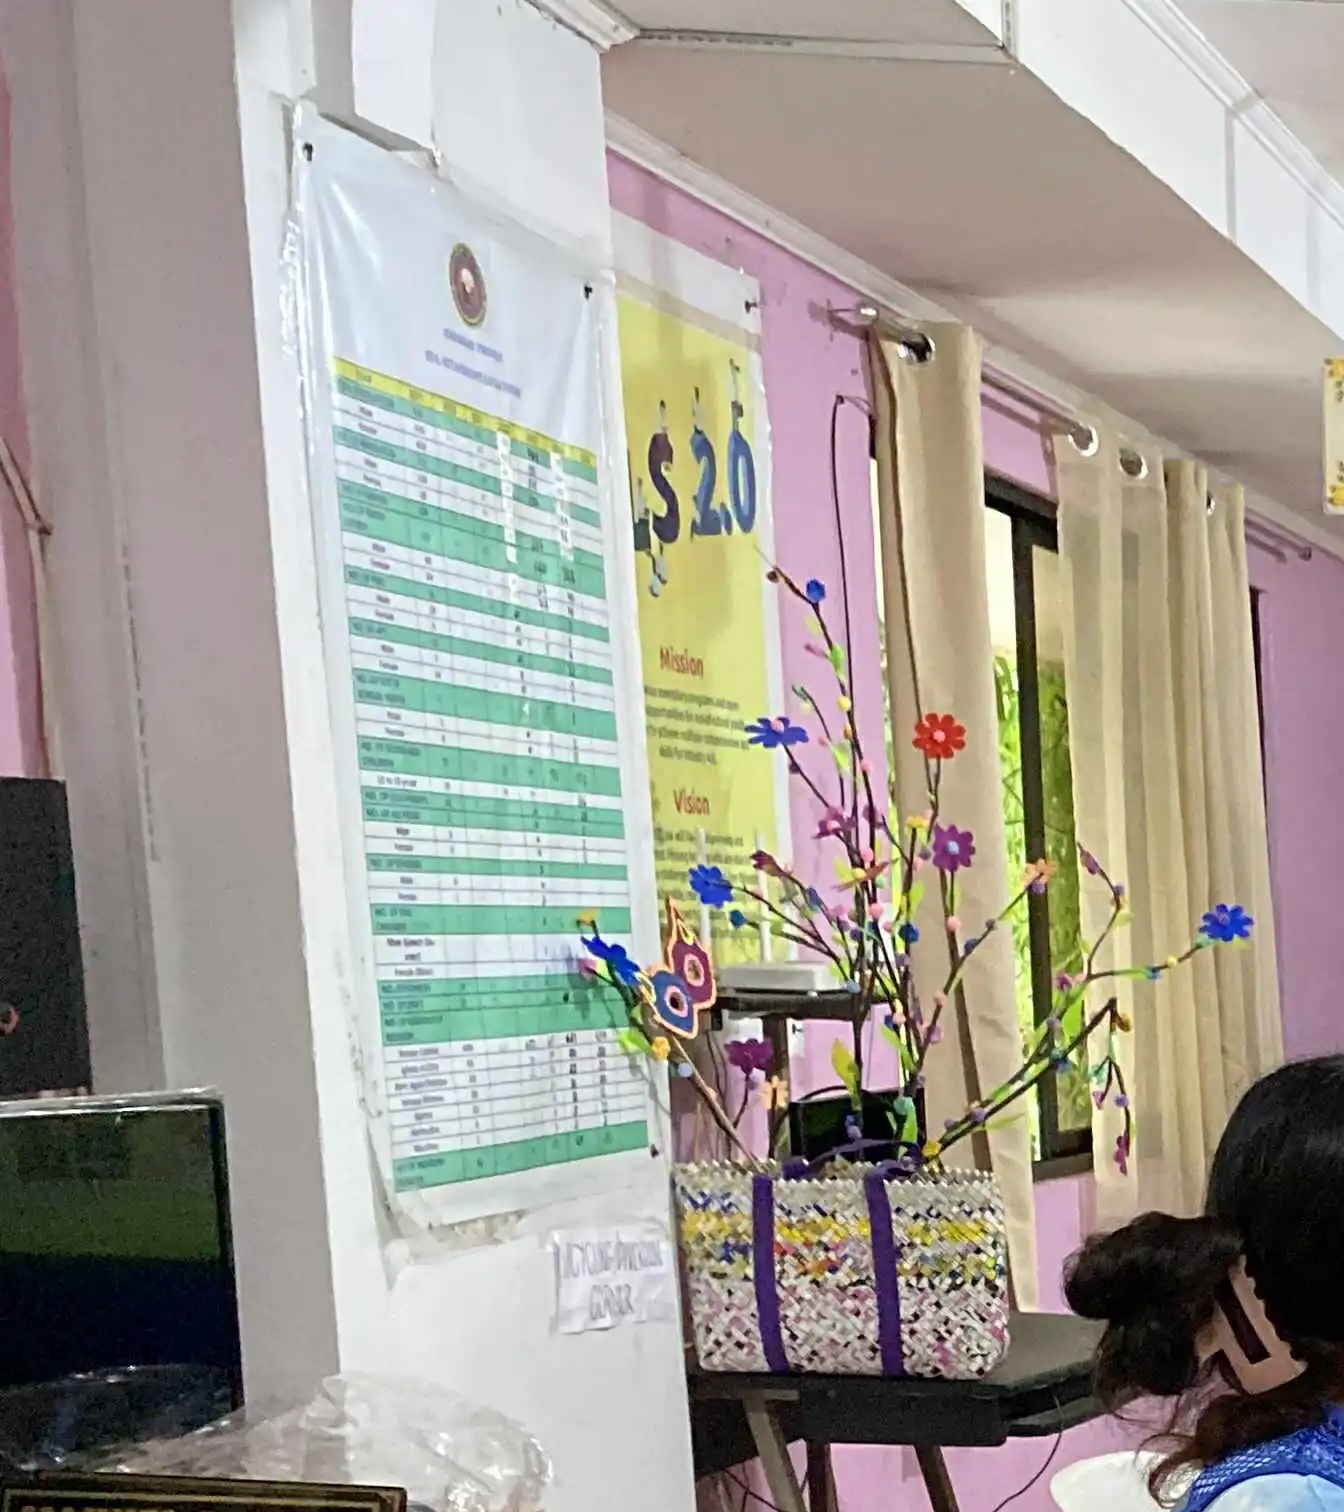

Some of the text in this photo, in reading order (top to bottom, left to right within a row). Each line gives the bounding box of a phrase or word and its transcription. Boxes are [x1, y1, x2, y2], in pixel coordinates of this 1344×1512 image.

[689, 430, 758, 537] 2.0
[659, 646, 704, 678] Mission
[673, 786, 710, 816] Vision
